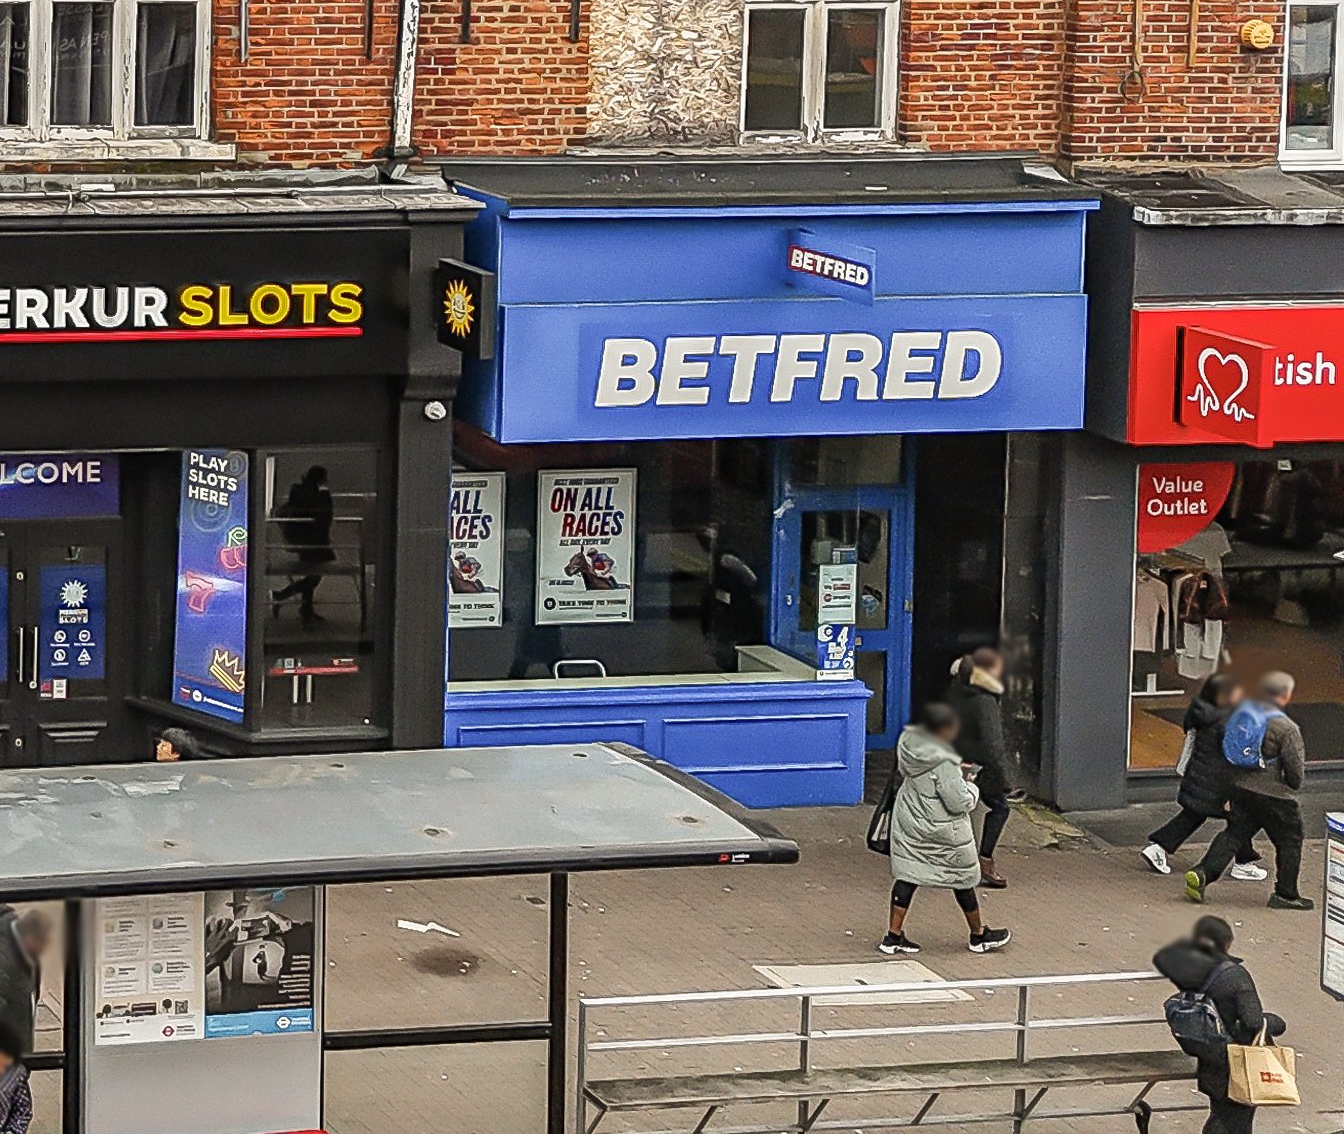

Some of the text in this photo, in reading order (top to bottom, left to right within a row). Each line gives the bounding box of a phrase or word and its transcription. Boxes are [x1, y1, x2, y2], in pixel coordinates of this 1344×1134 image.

[789, 244, 870, 288] BETFRED
[179, 283, 363, 326] SLOTS
[594, 330, 1002, 408] BETFRED
[190, 452, 228, 472] PLAY
[188, 468, 238, 492] SLOTS
[1153, 476, 1203, 493] Value
[188, 484, 229, 506] HERE
[551, 486, 615, 513] ON ALL
[1147, 498, 1208, 516] Outlet
[561, 511, 625, 538] RACES
